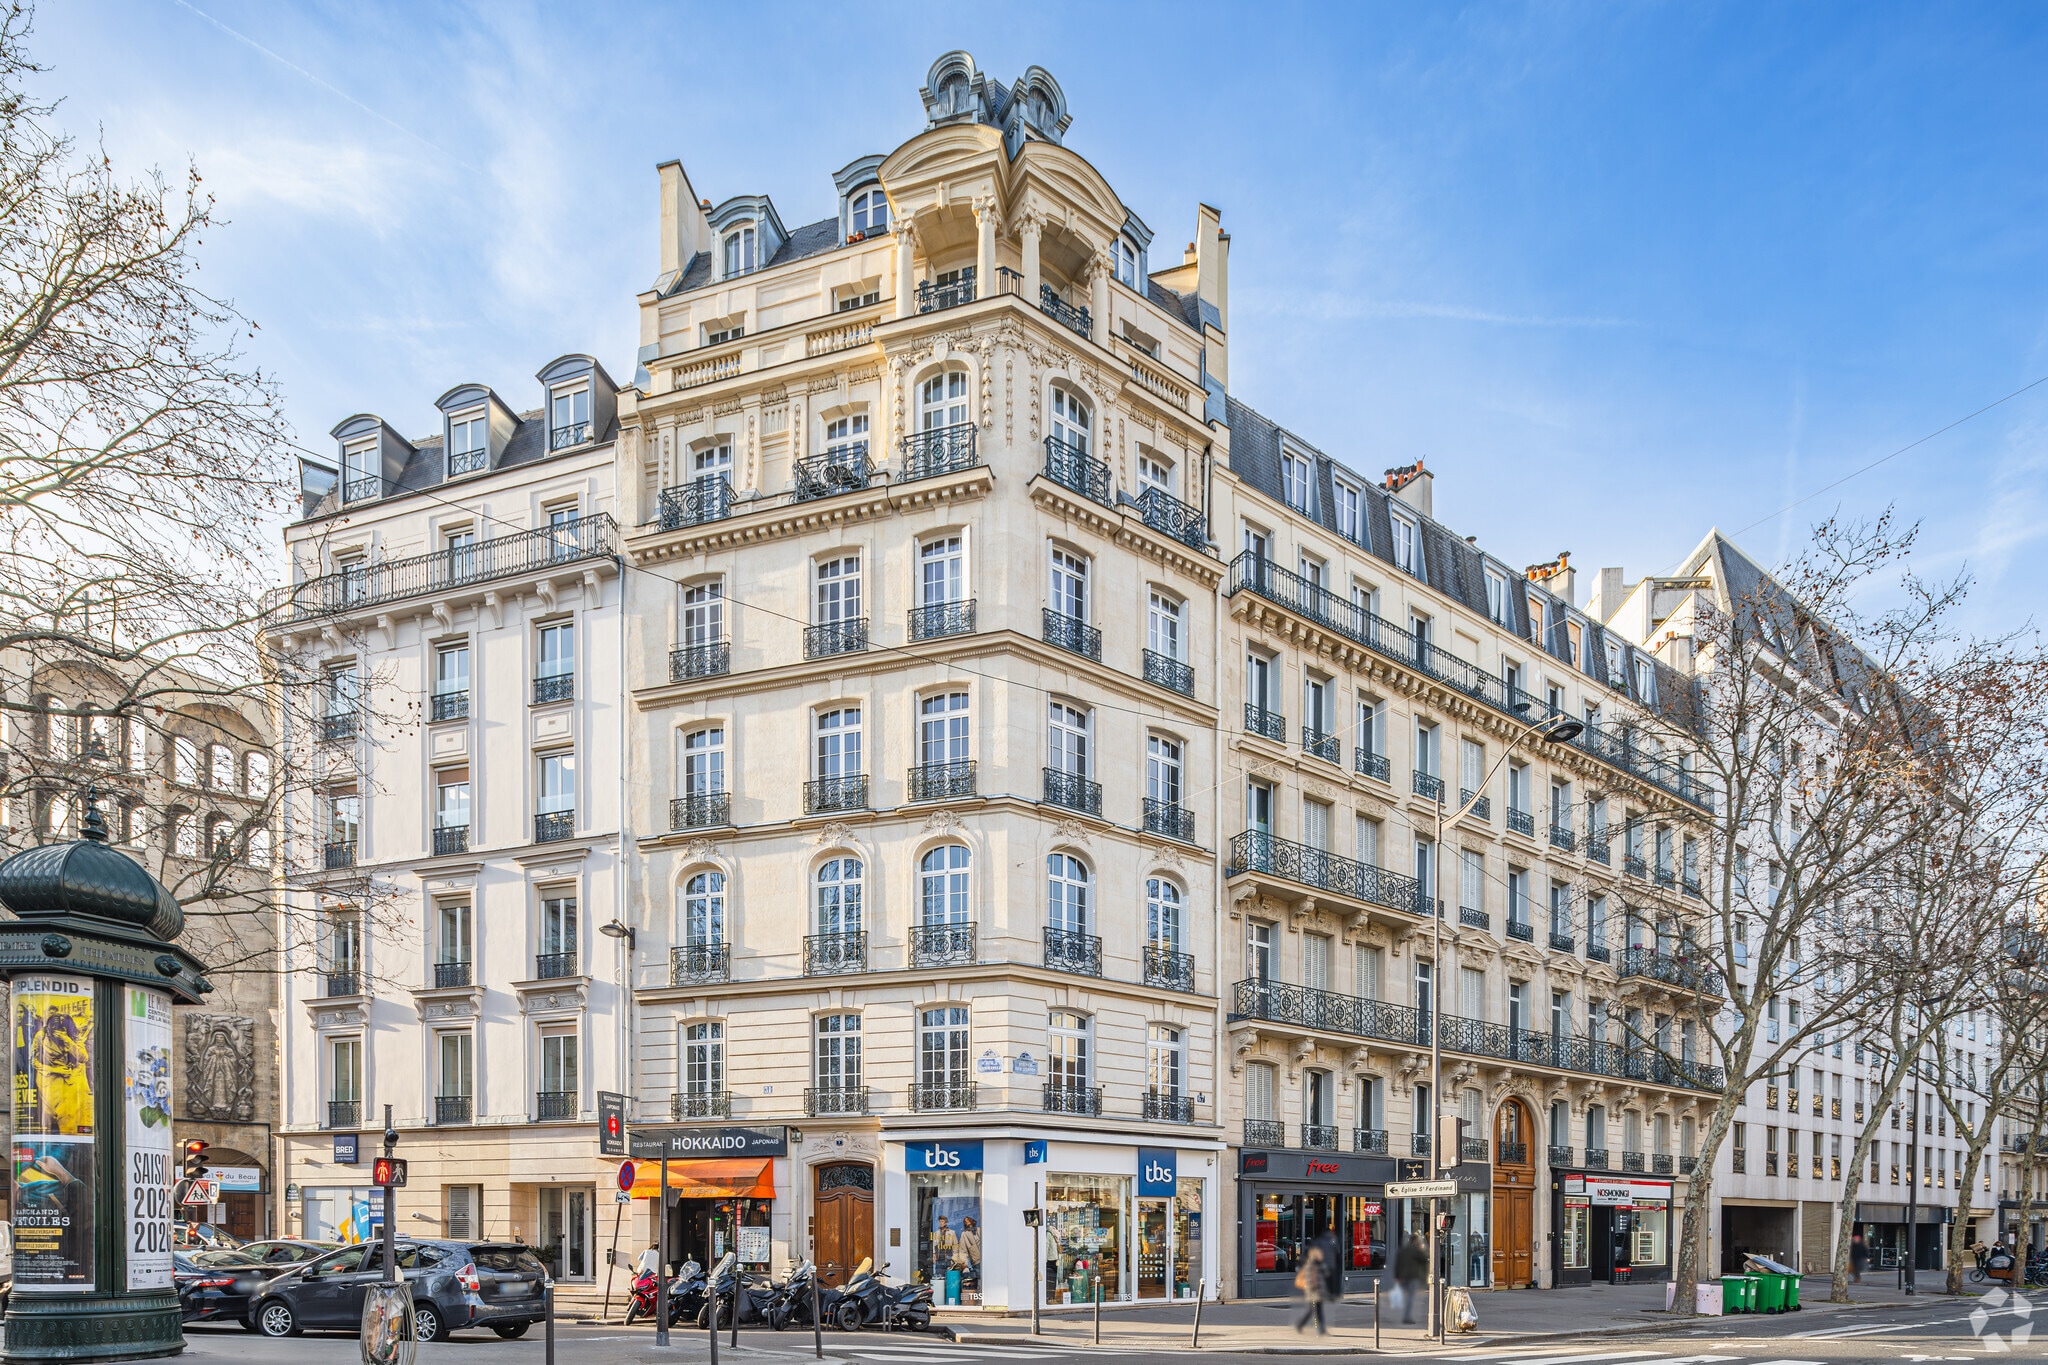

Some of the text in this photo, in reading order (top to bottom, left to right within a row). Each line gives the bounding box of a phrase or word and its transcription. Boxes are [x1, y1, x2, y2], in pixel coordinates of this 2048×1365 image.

[336, 1146, 354, 1154] BRED
[672, 1136, 746, 1151] HOKKAIDO
[1029, 1146, 1039, 1158] tbs
[925, 1143, 961, 1168] tbs
[1245, 1158, 1266, 1169] free
[1145, 1160, 1172, 1183] tbs
[1306, 1158, 1340, 1177] free
[134, 1187, 171, 1219] 2025
[134, 1221, 172, 1253] 2026
[968, 1292, 983, 1300] TBS
